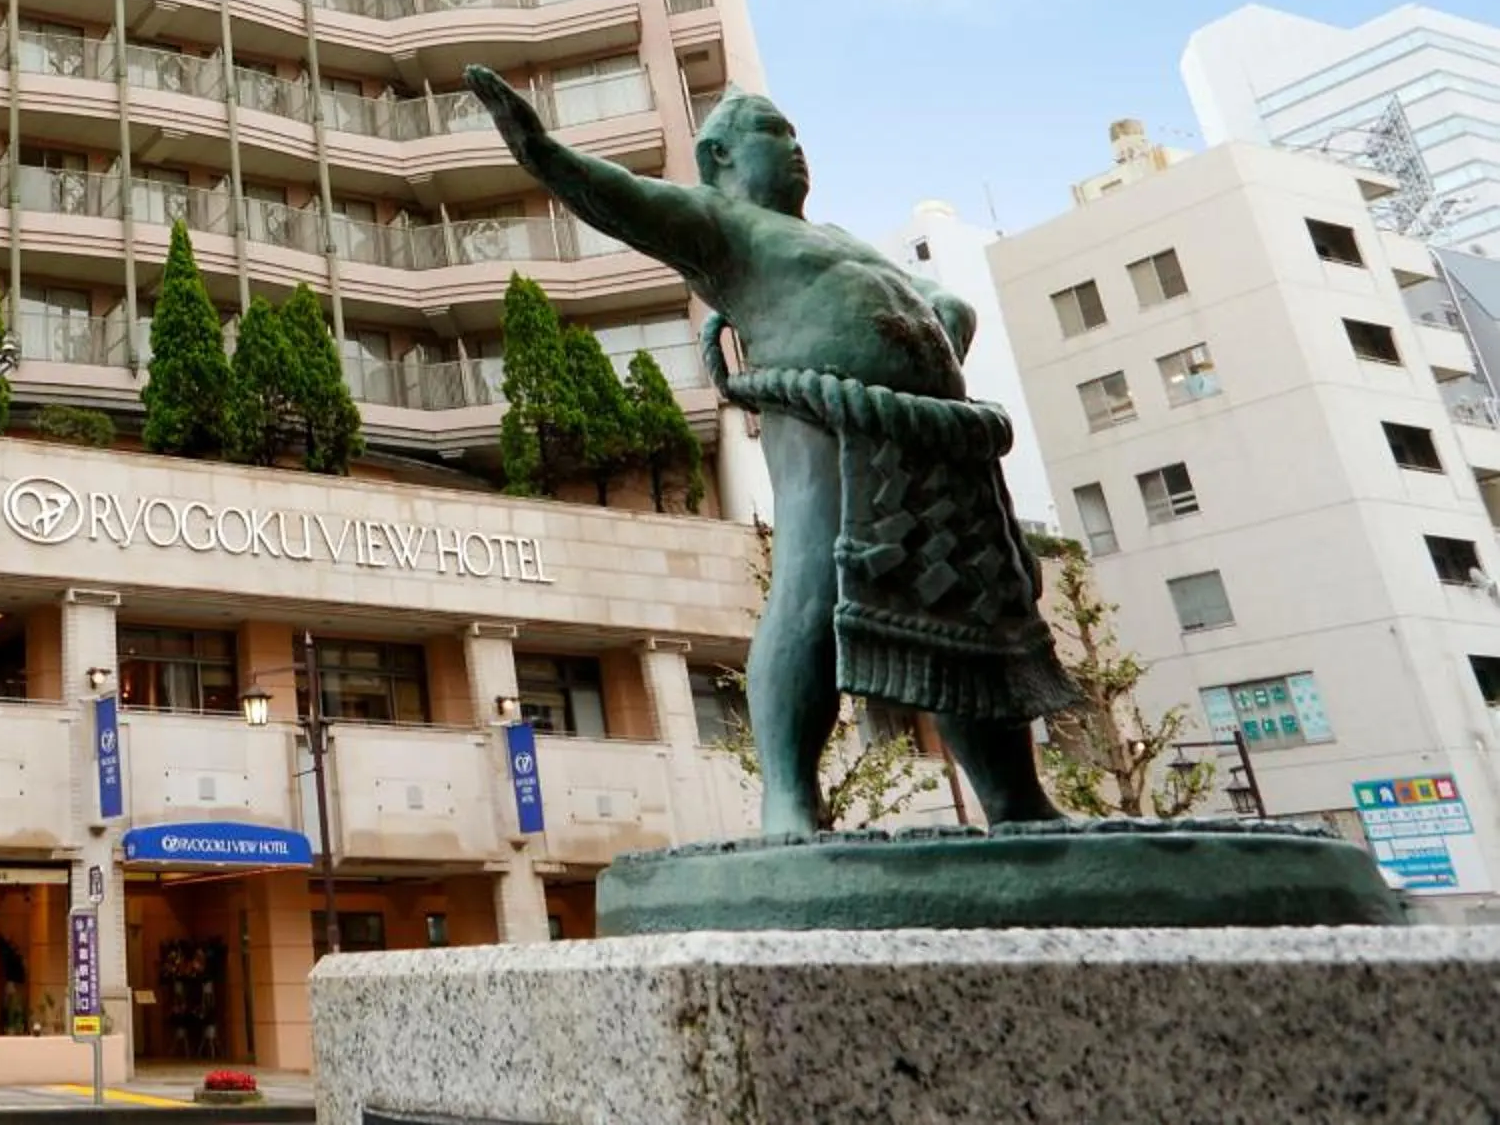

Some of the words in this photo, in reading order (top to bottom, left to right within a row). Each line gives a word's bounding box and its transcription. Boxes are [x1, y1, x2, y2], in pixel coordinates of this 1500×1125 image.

[88, 491, 312, 561] RYOGOKU
[314, 513, 427, 569] VIEW
[432, 527, 555, 584] HOTEL
[179, 837, 230, 853] RYOGOKU
[230, 839, 257, 854] VIEW
[259, 839, 289, 855] HOTEL
